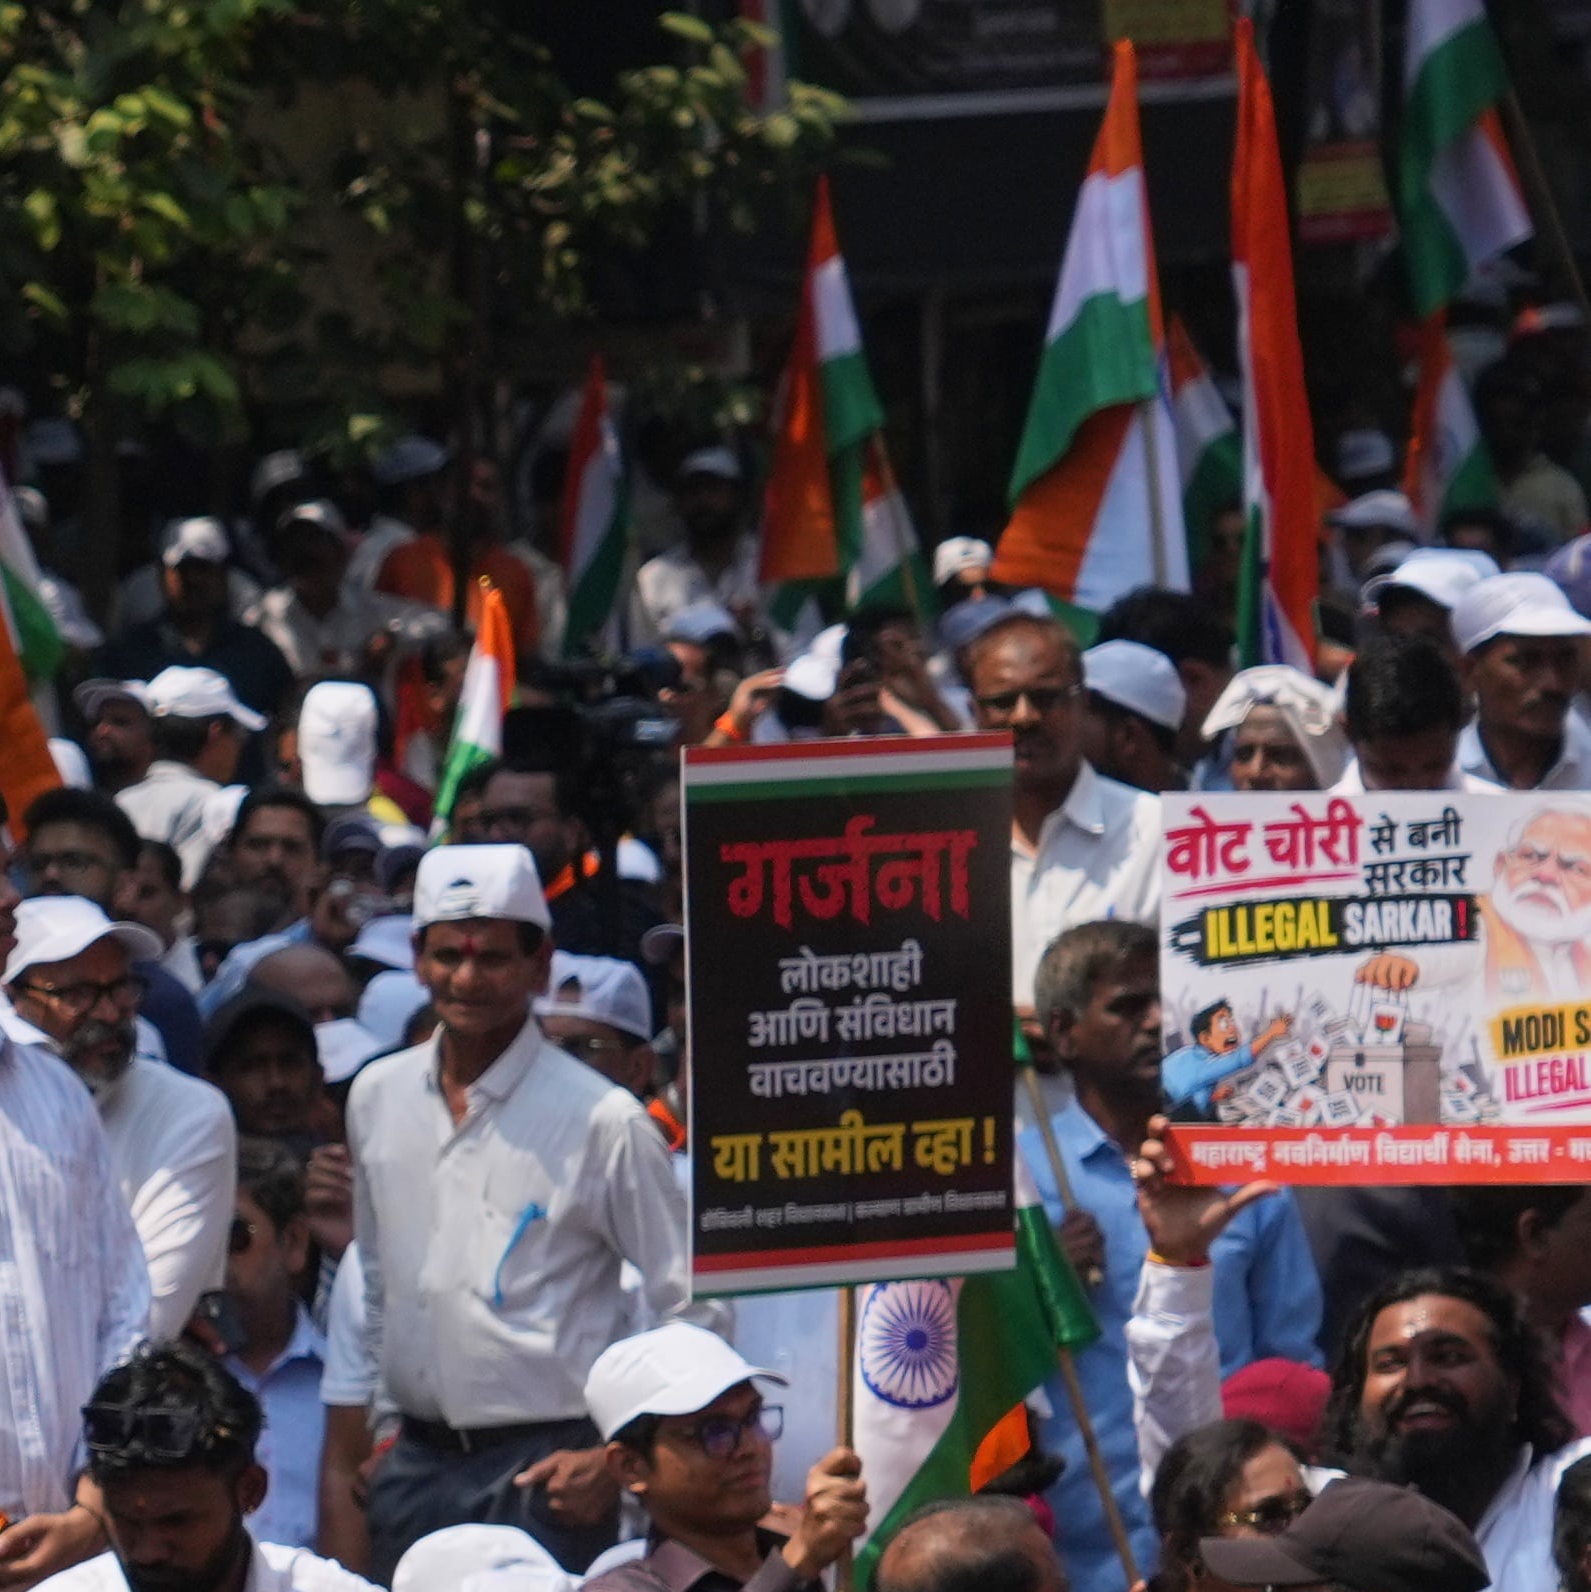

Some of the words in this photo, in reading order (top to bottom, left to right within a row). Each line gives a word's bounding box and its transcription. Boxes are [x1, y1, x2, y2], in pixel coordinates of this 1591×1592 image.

[1166, 804, 1253, 880] वोट
[1264, 797, 1364, 869] चोरी
[1370, 813, 1397, 854] से
[1407, 806, 1464, 849] बनी
[720, 814, 978, 930] गर्जना
[1364, 855, 1472, 894] सरकार
[1205, 900, 1338, 959] ILLEGAL
[1344, 899, 1453, 943] SARKAR
[779, 937, 923, 994] लोकशाही
[748, 996, 830, 1047] आणि
[835, 993, 956, 1042] संविधान
[1502, 1011, 1565, 1056] MODI
[748, 1039, 955, 1099] वाचवण्यासाठी
[1343, 1072, 1386, 1094] VOTE
[1505, 1056, 1590, 1102] ILLEGAL
[710, 1132, 762, 1183] या
[768, 1109, 905, 1180] सामील
[912, 1116, 975, 1176] व्हा
[1190, 1140, 1267, 1172] महाराष्ट्र
[1274, 1133, 1370, 1167] नवनिर्माण
[1508, 1138, 1550, 1164] उत्तर
